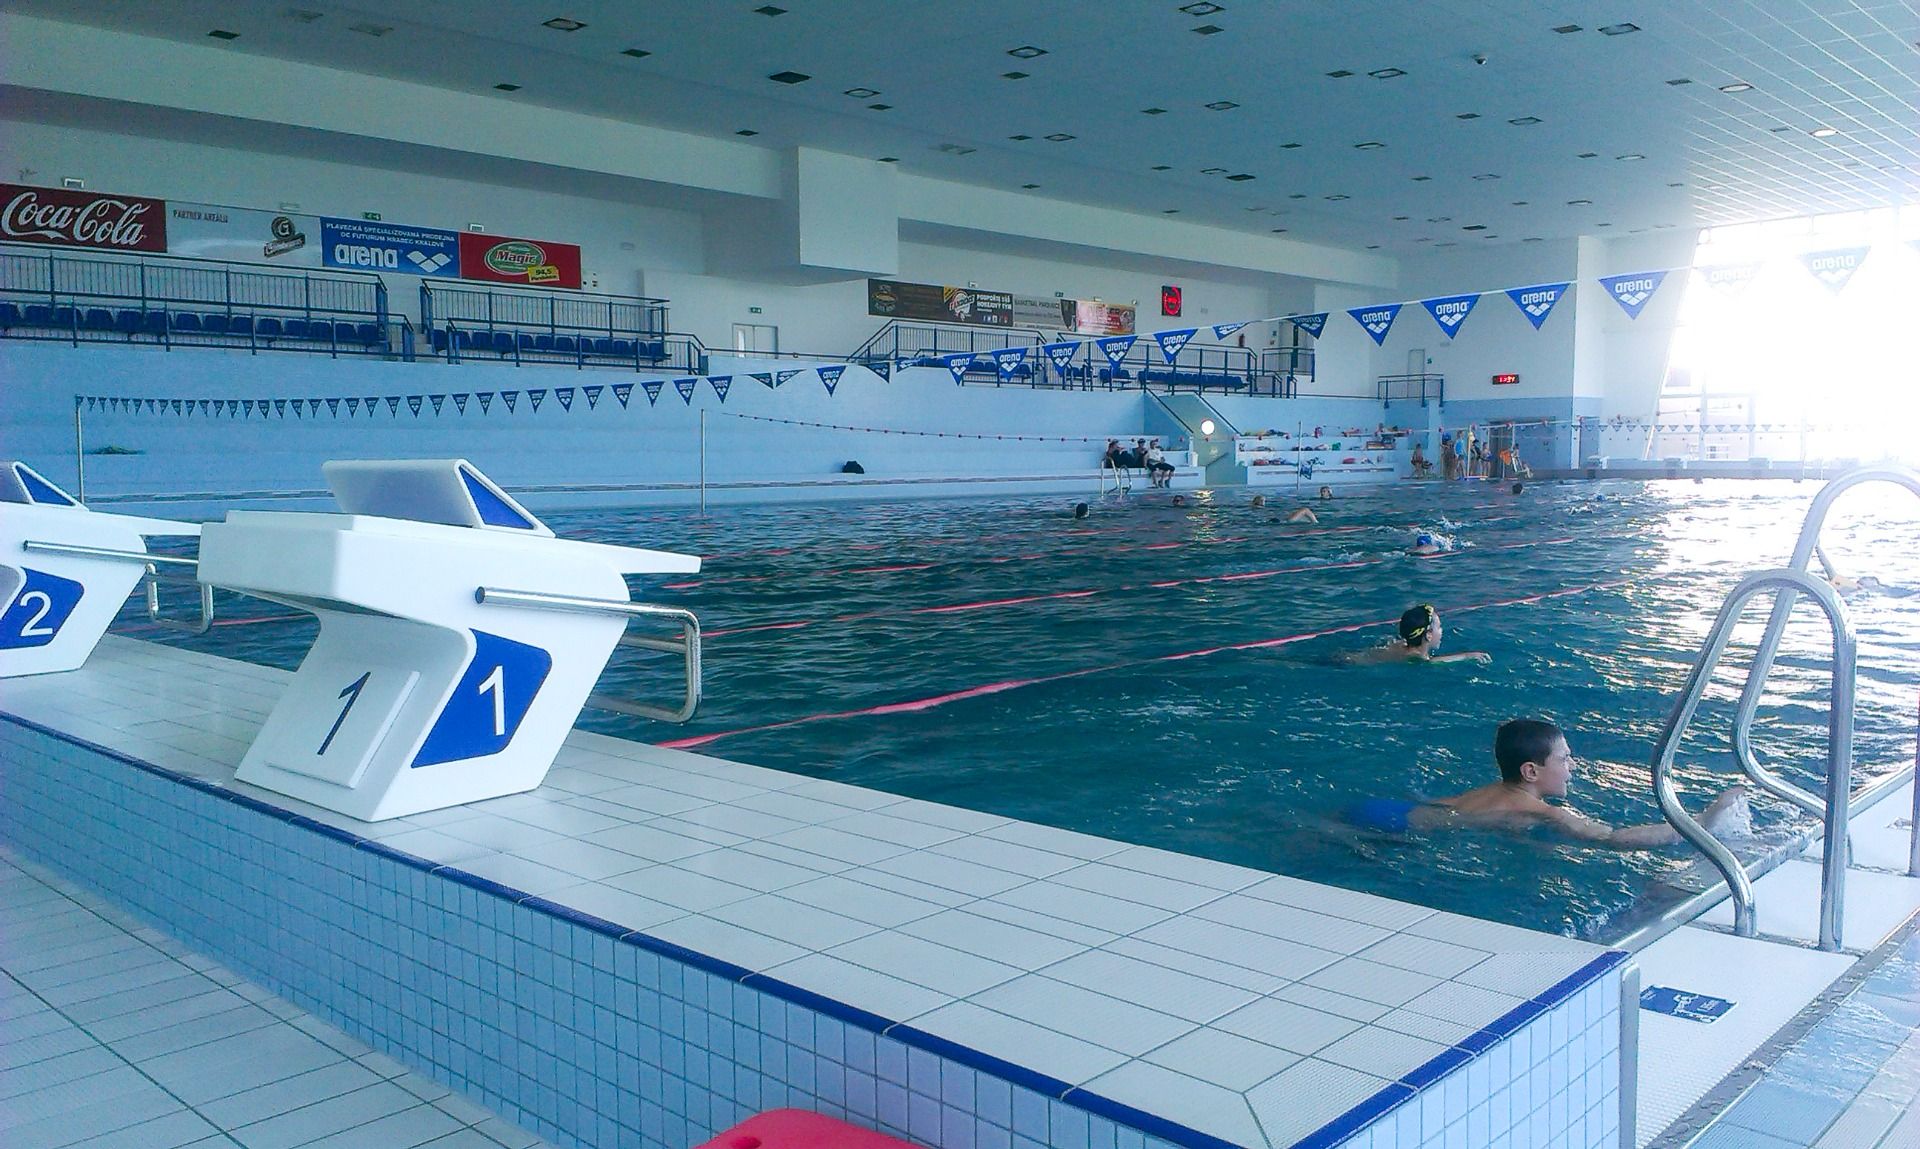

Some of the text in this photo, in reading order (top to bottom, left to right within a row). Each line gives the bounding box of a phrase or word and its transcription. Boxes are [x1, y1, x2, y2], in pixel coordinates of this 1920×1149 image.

[335, 243, 398, 268] arena
[495, 249, 537, 265] Magic
[1812, 255, 1855, 270] arena
[1615, 279, 1653, 293] arena
[1520, 290, 1557, 304] arena
[1435, 302, 1469, 315] arena
[1361, 311, 1392, 324] arena
[1106, 341, 1129, 351] arena
[1163, 335, 1188, 346] arena
[998, 352, 1022, 363] arena
[1052, 347, 1073, 358] arena
[950, 358, 971, 368] arena
[19, 590, 54, 637] 2
[477, 665, 506, 737] 1
[317, 671, 372, 756] 1
